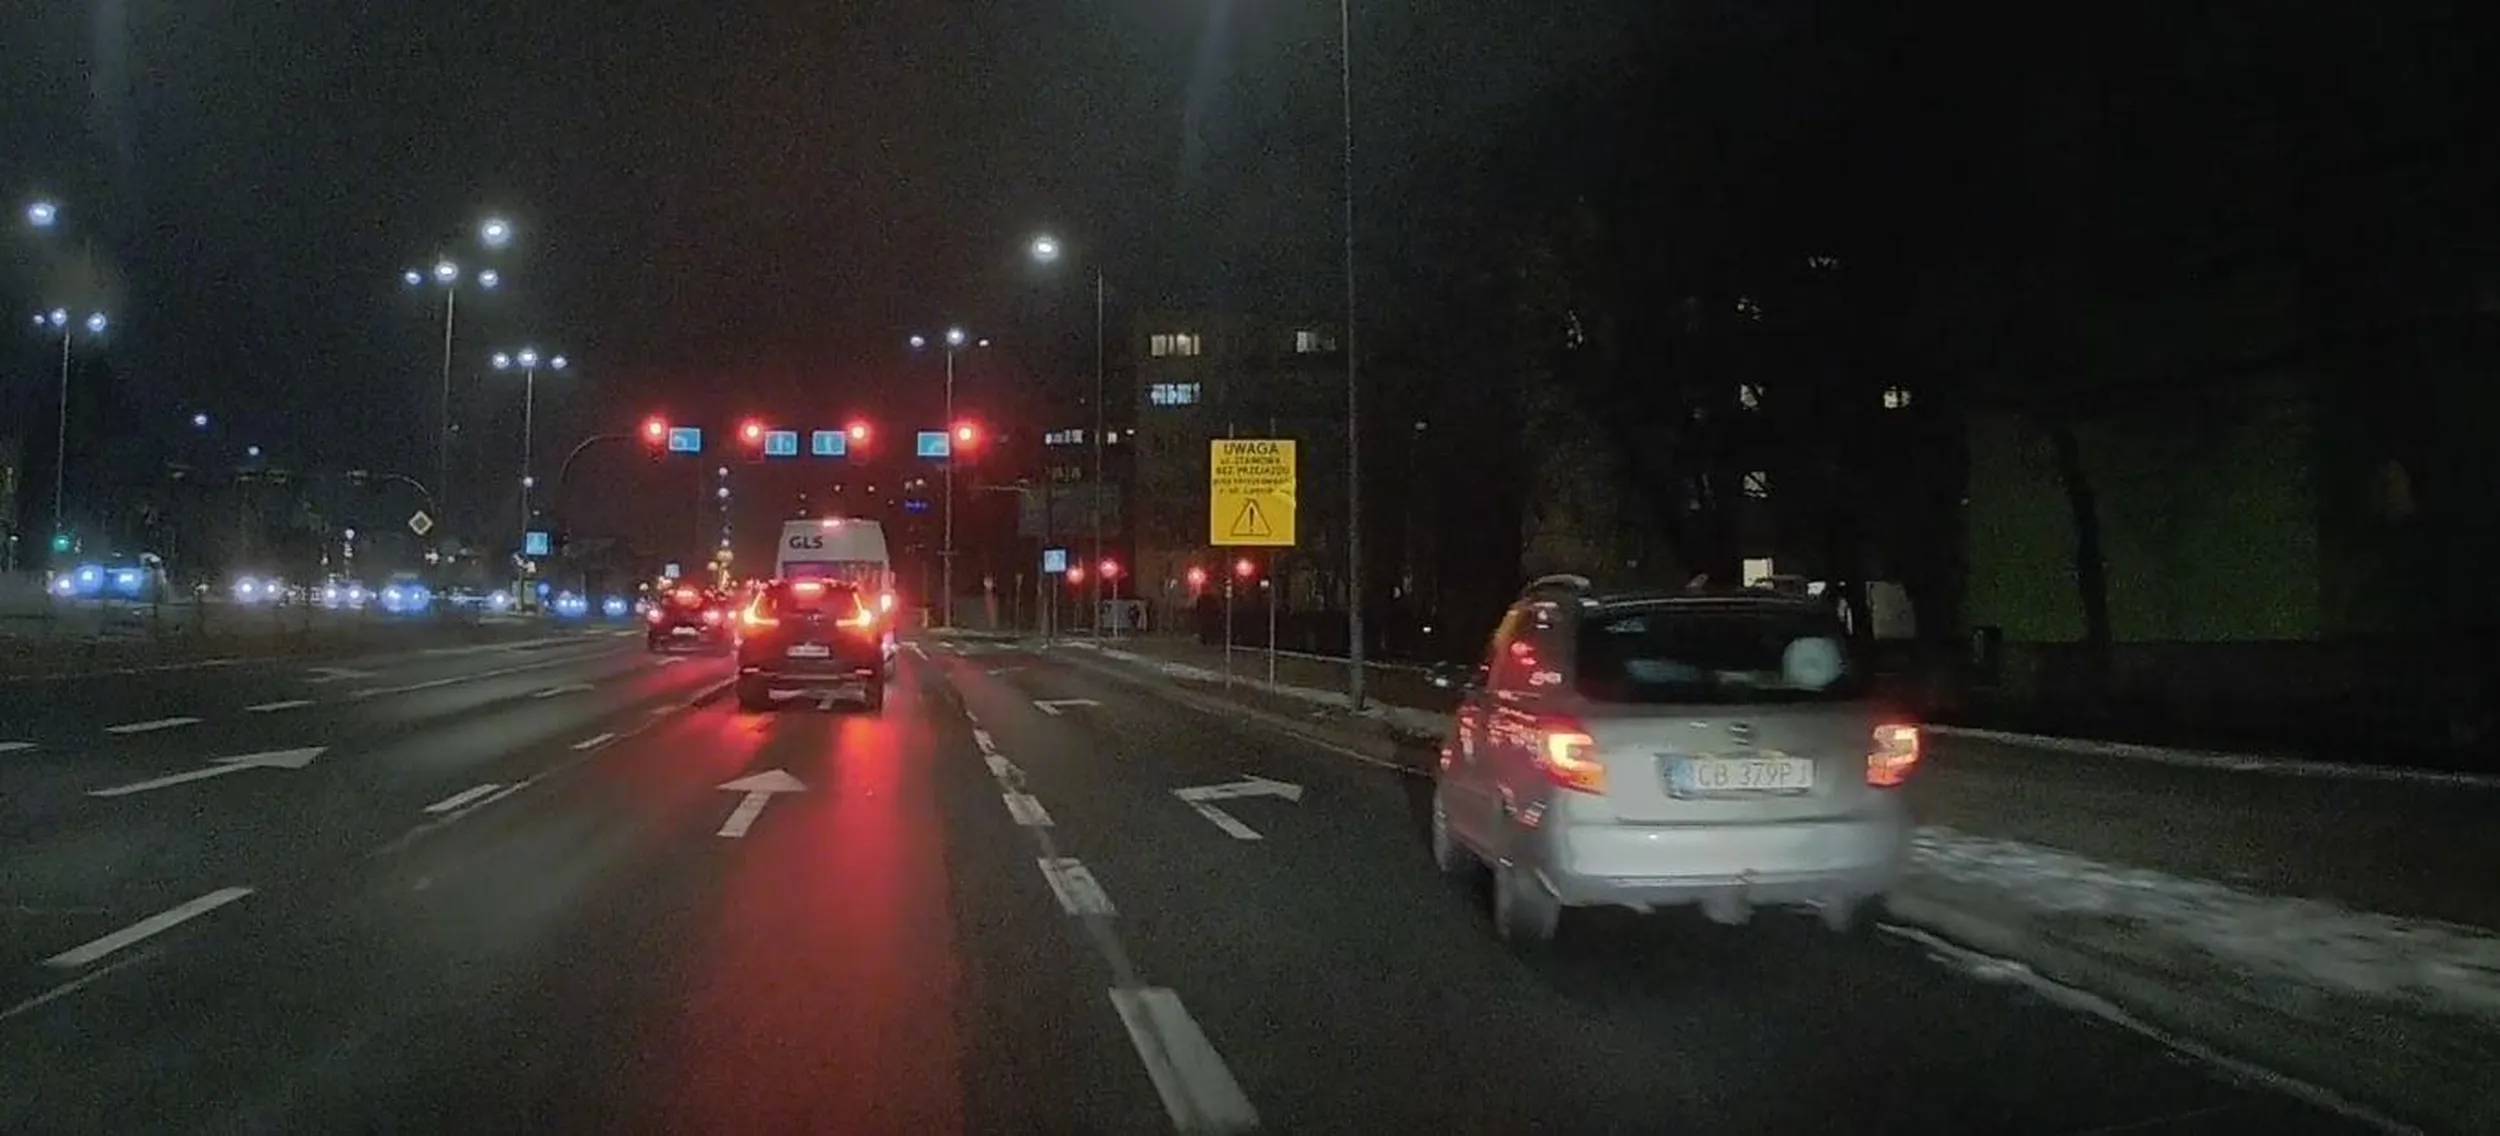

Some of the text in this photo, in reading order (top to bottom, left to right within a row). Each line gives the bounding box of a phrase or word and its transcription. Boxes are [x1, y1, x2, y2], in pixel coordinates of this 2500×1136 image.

[1223, 442, 1280, 455] UWAGA
[789, 535, 824, 549] GLS
[1698, 762, 1728, 787] CB
